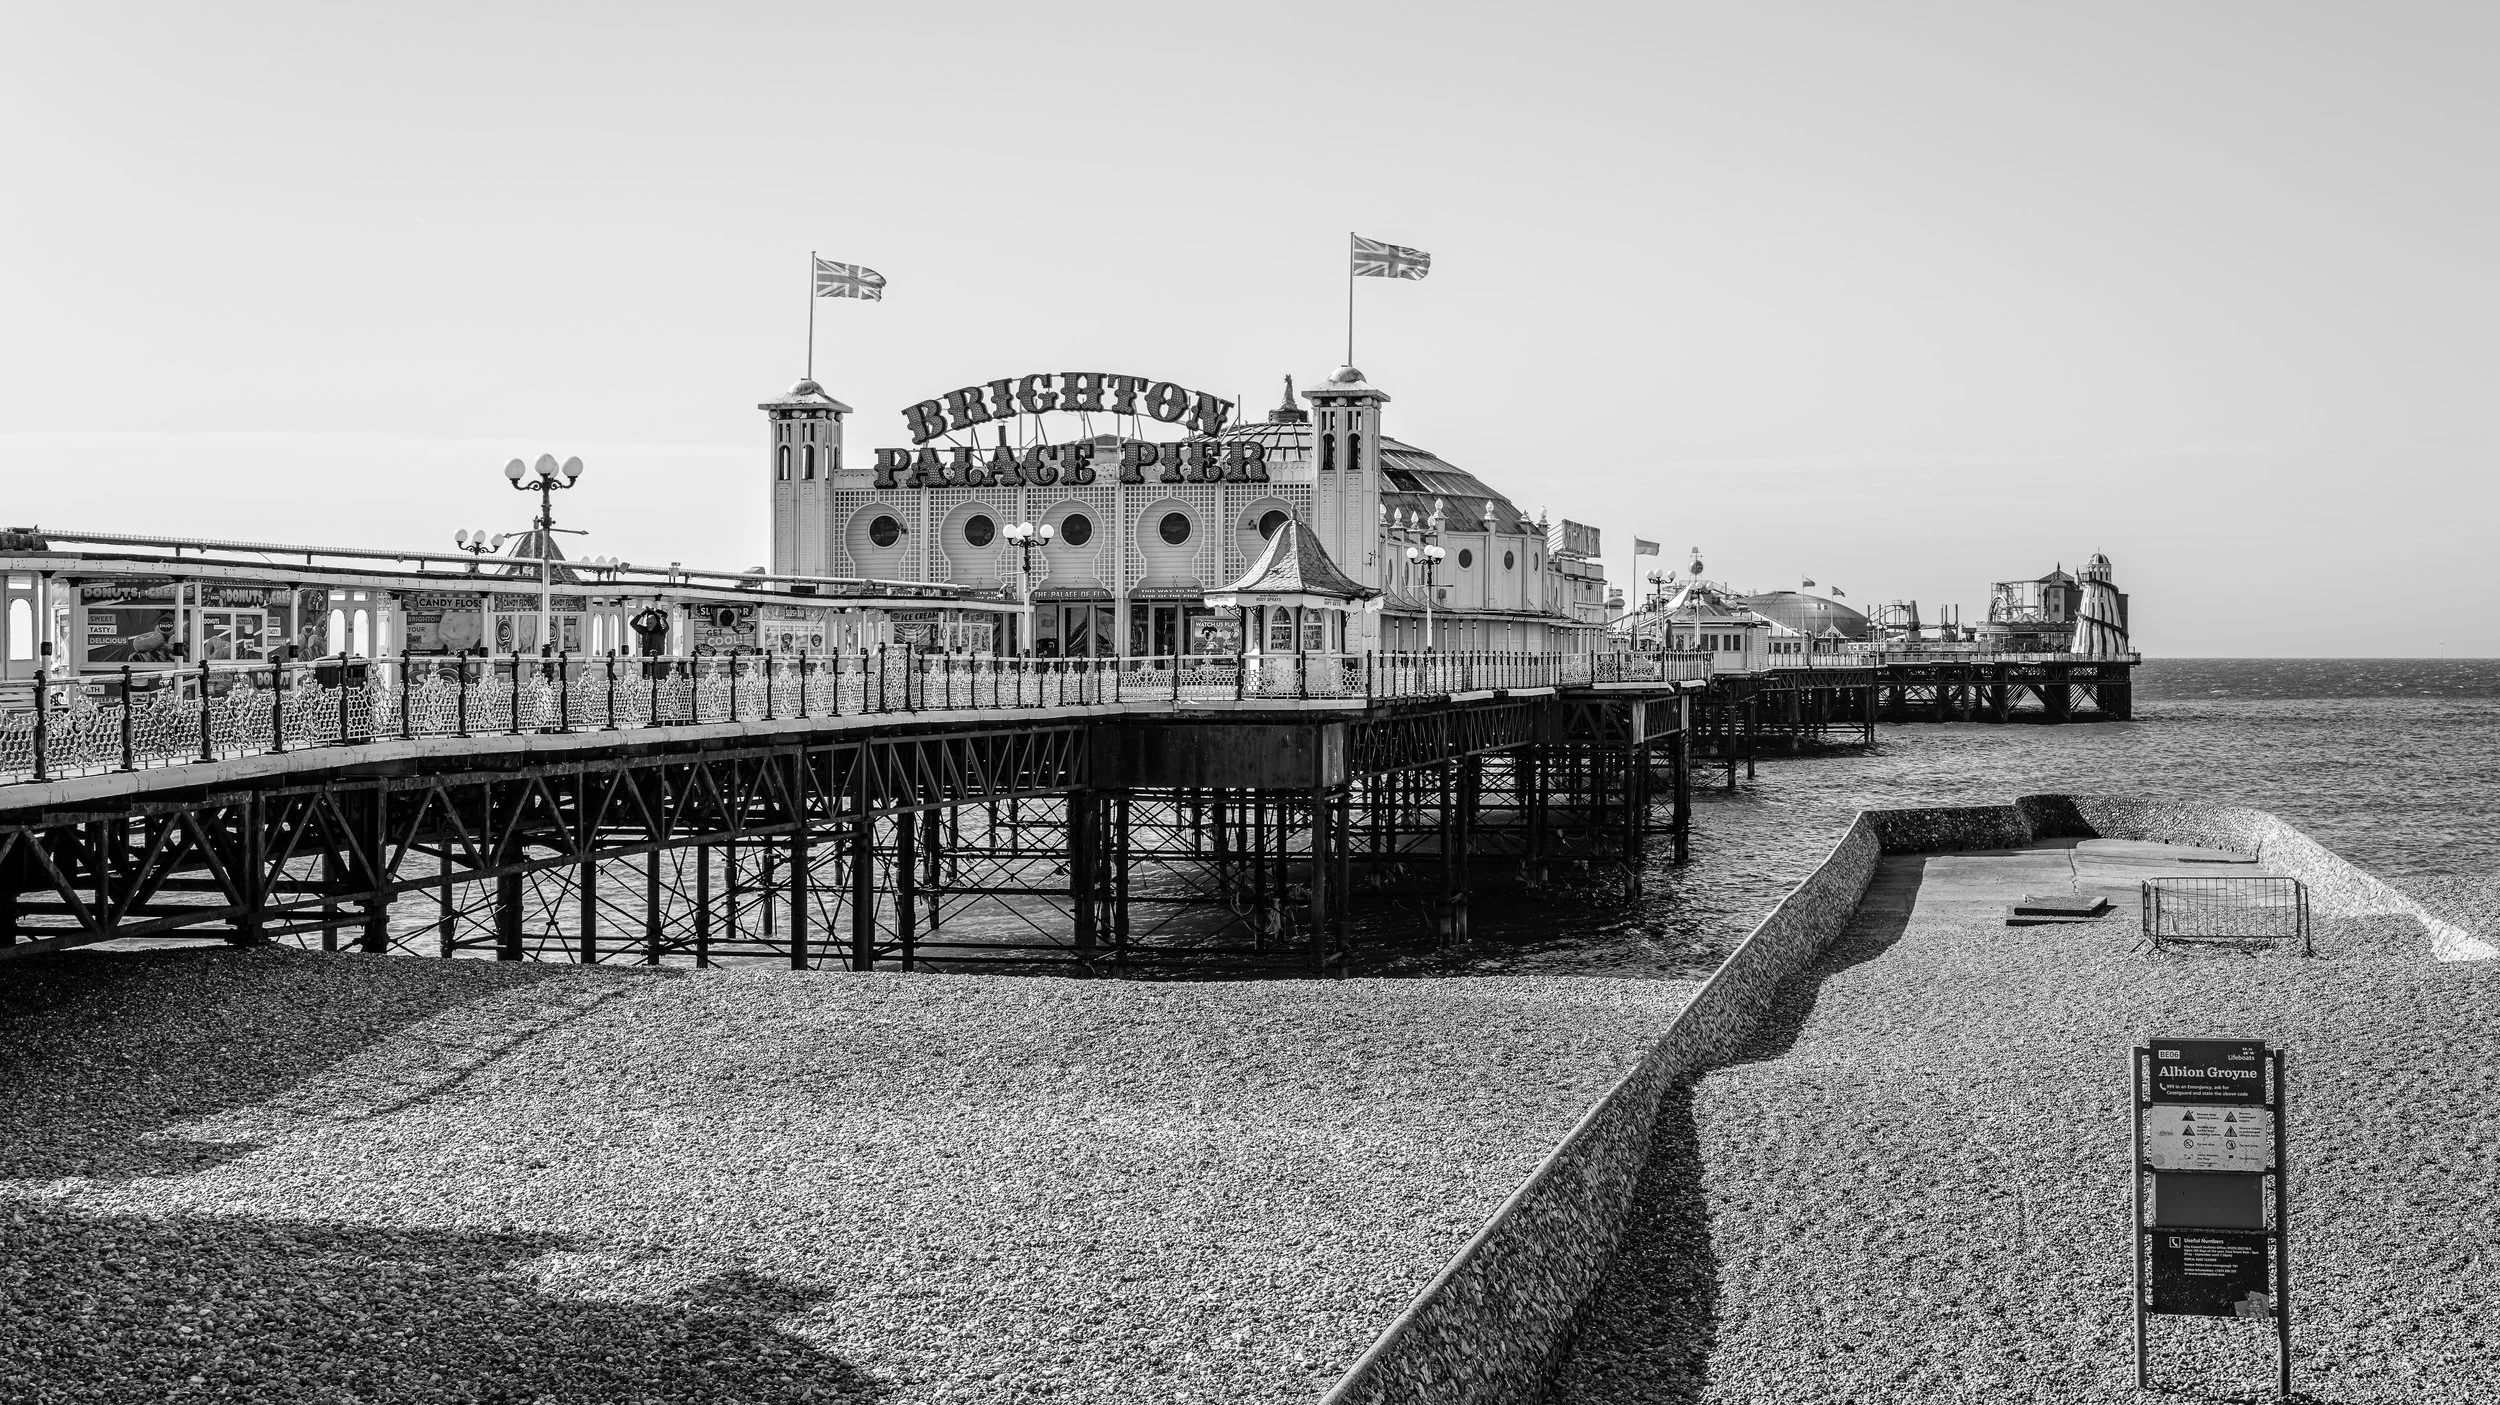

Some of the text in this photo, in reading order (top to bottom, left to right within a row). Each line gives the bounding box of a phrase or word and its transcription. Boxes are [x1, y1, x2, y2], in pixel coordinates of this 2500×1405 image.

[901, 372, 1235, 445] BRIGHTON
[874, 441, 1270, 488] PALACE PIER
[84, 587, 138, 599] DONUTS
[226, 588, 264, 603] DONUTS
[419, 598, 453, 608] CANDY
[503, 598, 520, 607] CANDY
[551, 598, 565, 607] CANDY
[901, 612, 913, 620] ICE
[914, 611, 939, 620] CREAM
[706, 628, 723, 637] GET
[707, 634, 743, 646] COOL!
[2158, 1066, 2258, 1080] Albion Groyne
